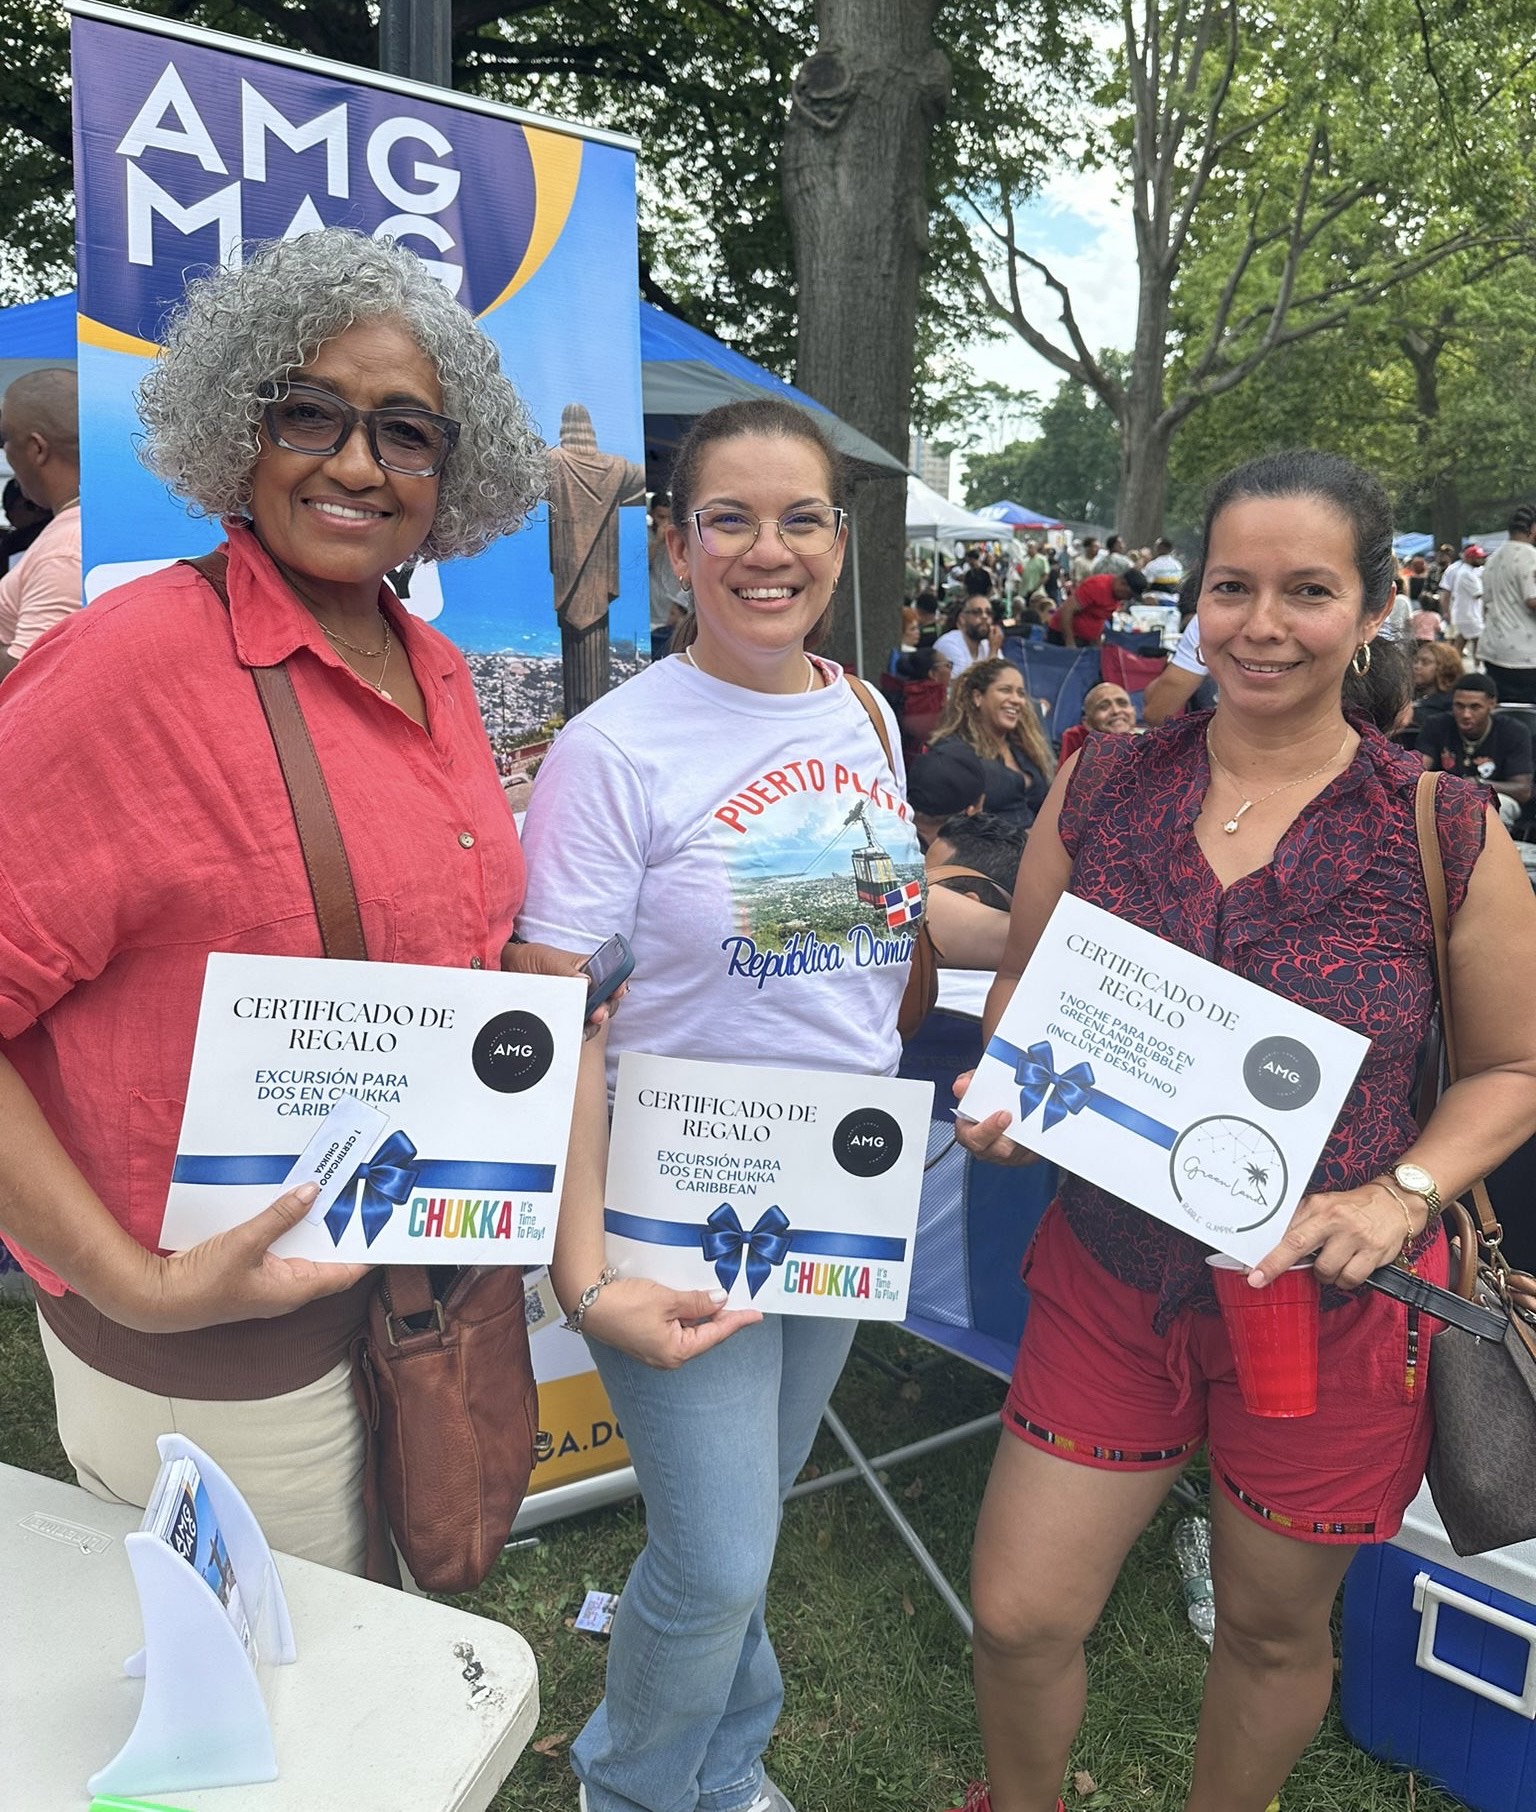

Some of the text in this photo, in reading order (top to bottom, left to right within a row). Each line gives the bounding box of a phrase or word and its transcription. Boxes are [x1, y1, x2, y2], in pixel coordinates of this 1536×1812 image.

[115, 61, 461, 215] AMG
[714, 758, 826, 835] PUERTO
[721, 931, 845, 989] República
[1066, 934, 1240, 1031] CERTIFICADO DE
[233, 997, 455, 1029] CERTIFICADO DE
[1098, 975, 1185, 1029] REGALO
[289, 1029, 397, 1053] REGALO
[1060, 991, 1195, 1067] 1 NOCHE PARA DOS EN
[1060, 1004, 1185, 1074] GREENLAND BUBBLE
[493, 1044, 533, 1057] AMG
[1046, 1022, 1177, 1098] (INCLUYE DESAYUNO)
[1082, 1028, 1148, 1068] GLAMPING
[255, 1068, 408, 1087] EXCURSIÓN PARA
[1263, 1061, 1300, 1084] AMG
[257, 1086, 295, 1100] DOS
[300, 1087, 324, 1101] EN
[638, 1089, 818, 1123] CERTIFICADO DE
[683, 1119, 771, 1143] REGALO
[850, 1135, 885, 1148] AMG
[314, 1142, 339, 1174] CHUKKA
[319, 1135, 357, 1186] CERTIFICADO
[657, 1150, 781, 1171] EXCURSIÓN PARA
[659, 1164, 776, 1183] DOS EN CHUKKA
[1183, 1156, 1231, 1188] Green
[675, 1180, 757, 1195] CARIBBEAN
[408, 1197, 512, 1239] CHUKKA
[519, 1214, 537, 1226] Time
[520, 1201, 533, 1213] It's
[517, 1227, 545, 1240] To Play!
[784, 1260, 870, 1299] CHUKKA
[175, 1503, 191, 1549] AMG
